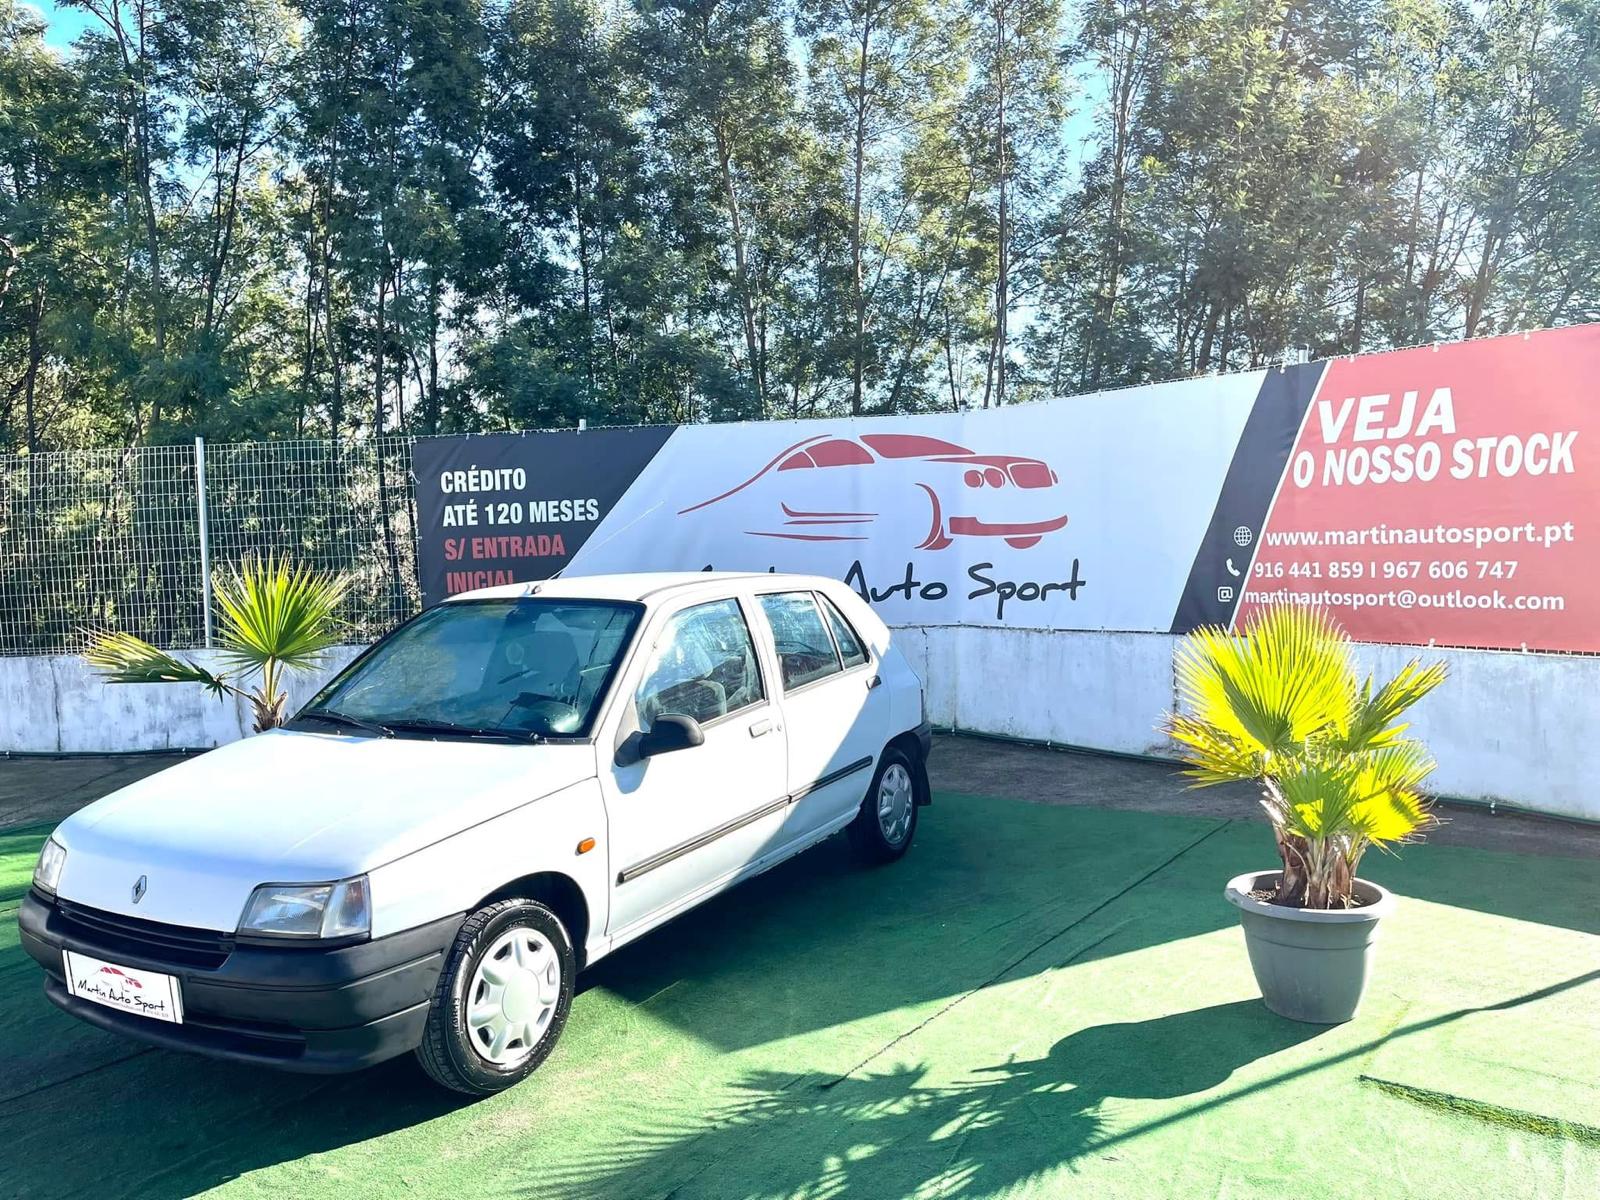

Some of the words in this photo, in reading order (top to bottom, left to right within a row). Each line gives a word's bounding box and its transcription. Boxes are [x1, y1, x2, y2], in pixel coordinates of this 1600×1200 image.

[1318, 387, 1456, 444] VEJA
[1293, 451, 1315, 488] O
[1321, 442, 1441, 486] NOSSO
[1450, 431, 1579, 480] STOCK
[440, 465, 527, 494] CRÉDITO
[442, 499, 478, 527] ATÉ
[485, 502, 523, 525] 120
[529, 498, 599, 523] MESES
[444, 537, 466, 560] S/
[471, 534, 566, 560] ENTRADA
[1266, 520, 1574, 548] www.martinautosport.pt
[1254, 562, 1284, 578] 916
[1288, 562, 1322, 578] 441
[1328, 561, 1364, 579] 859
[1382, 561, 1422, 578] 967
[1428, 561, 1469, 579] 606
[1475, 560, 1519, 579] 747
[843, 560, 948, 603] Auto
[967, 559, 1087, 620] Sport
[1245, 588, 1565, 611] martinautosport@outlook.com
[78, 979, 106, 997] Martin
[108, 988, 132, 1004] Auto
[133, 995, 166, 1013] Sport
